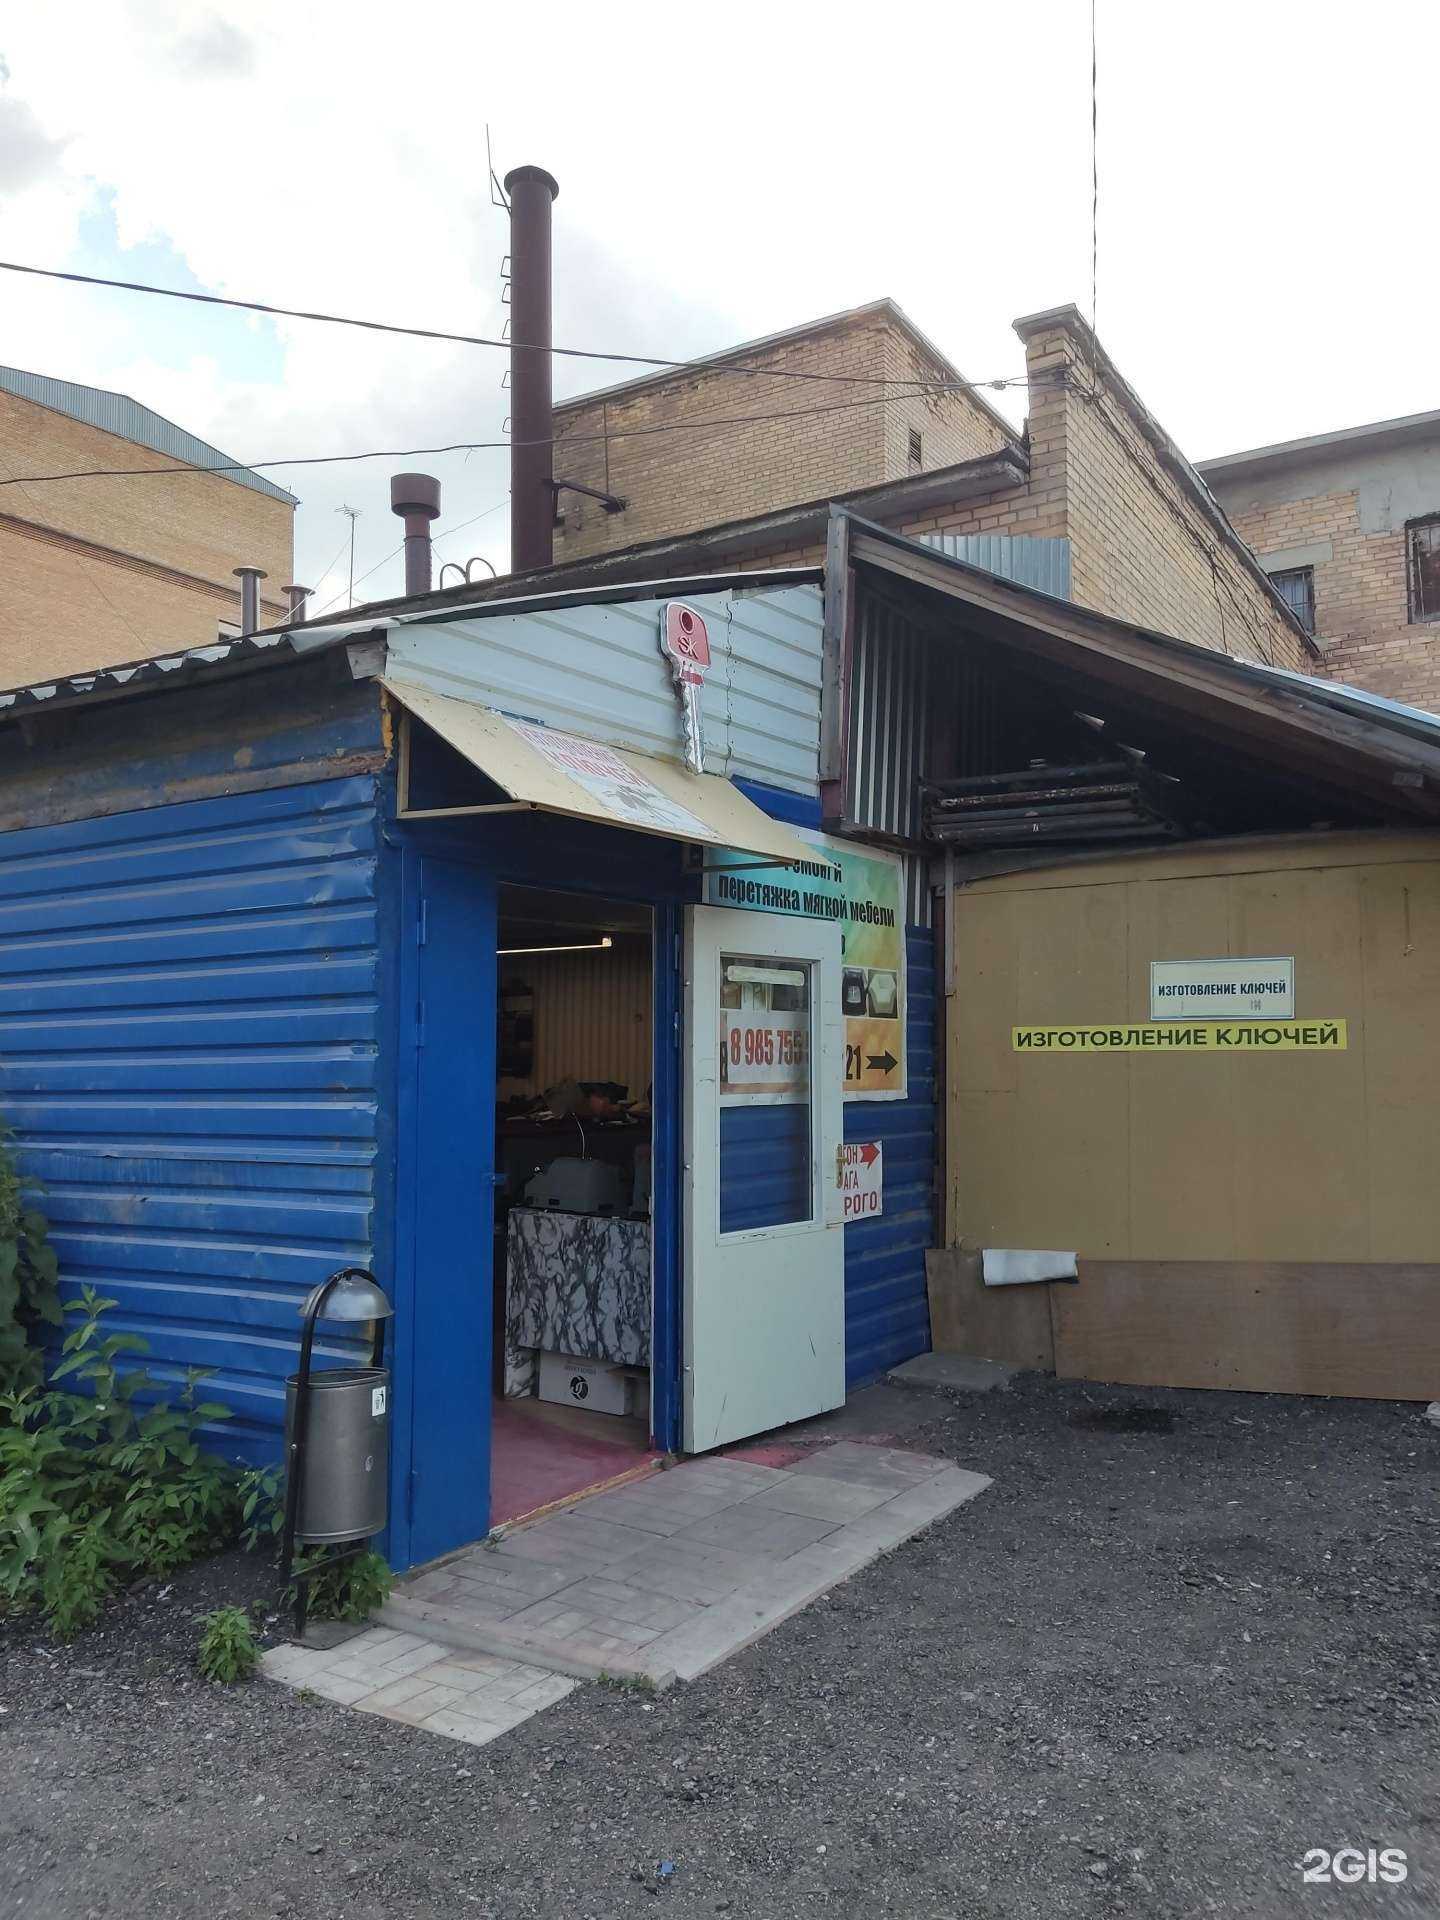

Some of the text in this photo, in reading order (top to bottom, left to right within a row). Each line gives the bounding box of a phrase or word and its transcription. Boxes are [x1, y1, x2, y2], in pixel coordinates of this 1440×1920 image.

[678, 635, 699, 660] SK
[784, 859, 831, 880] емонт
[718, 875, 895, 928] перетяжка мягкой мебели
[1158, 979, 1287, 997] ИЗГОТОВЛЕНИЕ КЛЮЧЕЙ
[730, 1028, 742, 1066] 8
[745, 1028, 774, 1066] 985
[1016, 1023, 1338, 1048] ИЗГОТОВЛЕНИЕ КЛЮЧЕЙ
[843, 1170, 859, 1191] АГА
[844, 1191, 878, 1216] РОГО
